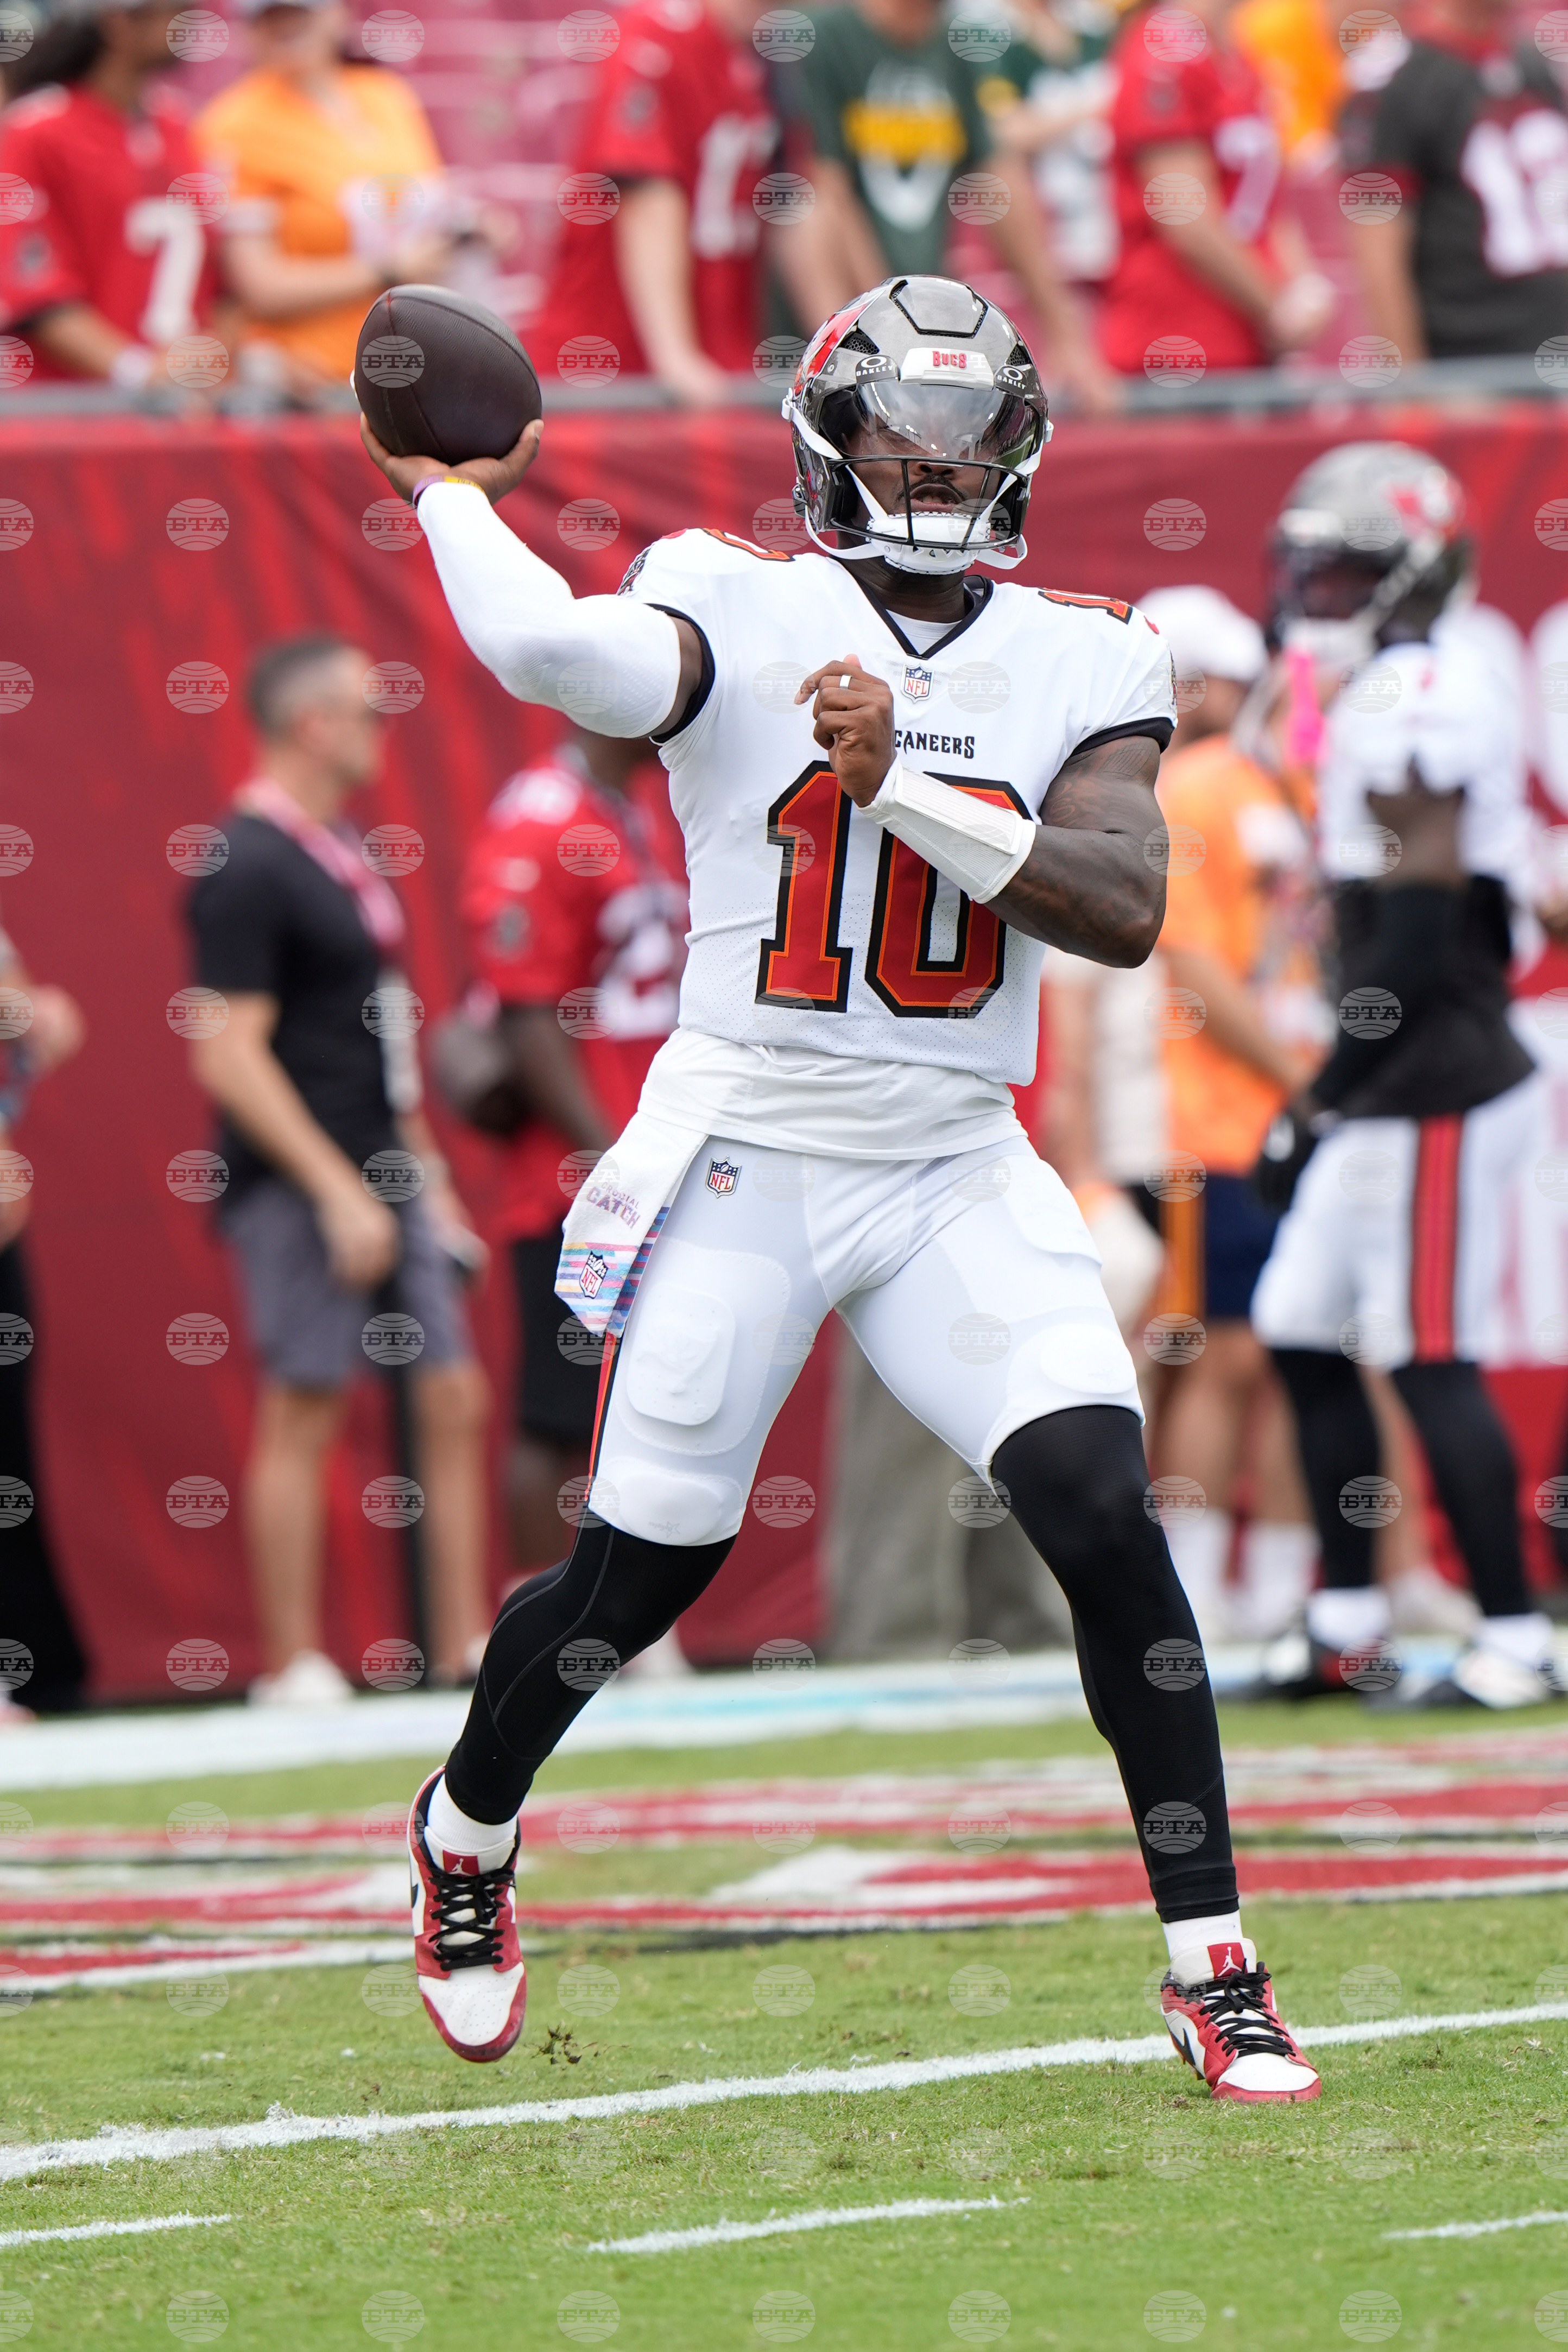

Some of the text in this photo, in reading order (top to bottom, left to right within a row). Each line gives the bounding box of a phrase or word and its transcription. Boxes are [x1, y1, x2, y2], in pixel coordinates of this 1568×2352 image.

[856, 365, 893, 377] OAKLEY
[997, 375, 1027, 390] OAKLEY
[906, 679, 927, 696] NFL
[895, 730, 975, 759] CANEERS
[755, 760, 1033, 1019] 10
[710, 1173, 731, 1191] NFL
[586, 1186, 641, 1229] CATCH
[581, 1267, 599, 1295] NFL
